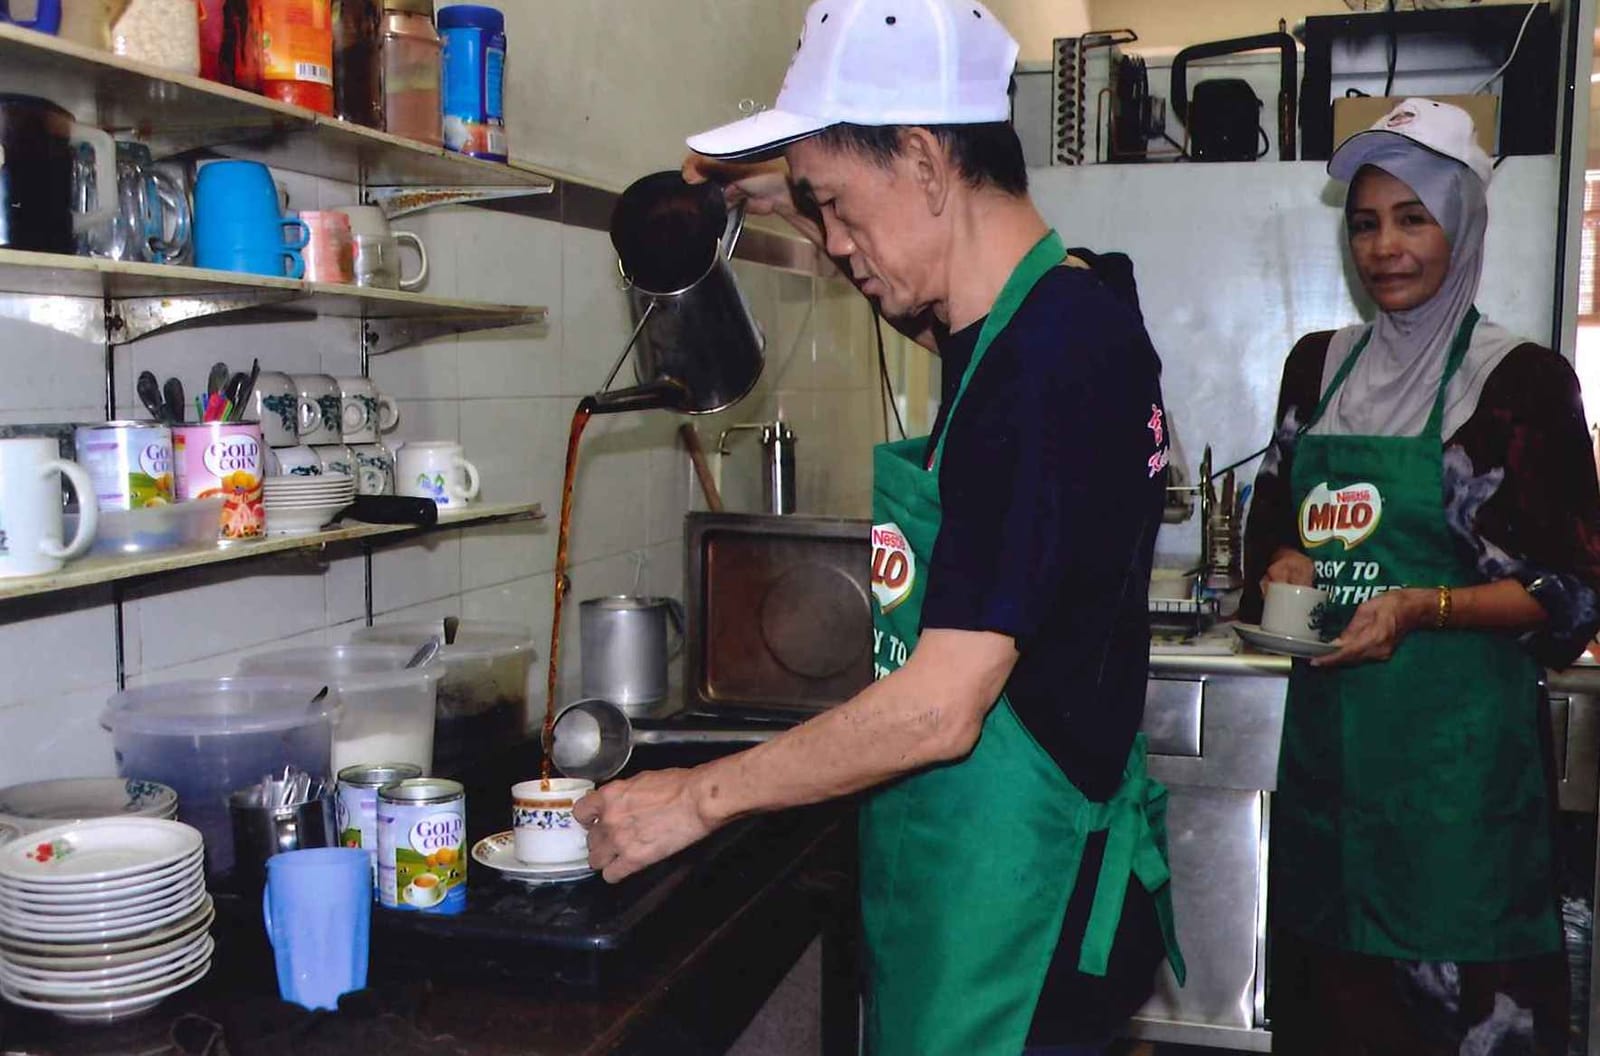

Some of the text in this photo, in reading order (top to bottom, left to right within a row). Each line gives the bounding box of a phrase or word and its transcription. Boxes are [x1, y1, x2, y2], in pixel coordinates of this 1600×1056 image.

[210, 442, 258, 457] GOLD
[219, 457, 255, 470] COIN
[1308, 502, 1373, 532] MILO
[1352, 561, 1380, 581] TO
[889, 634, 907, 666] TO
[416, 819, 462, 837] GOLD
[423, 834, 459, 849] COIN
